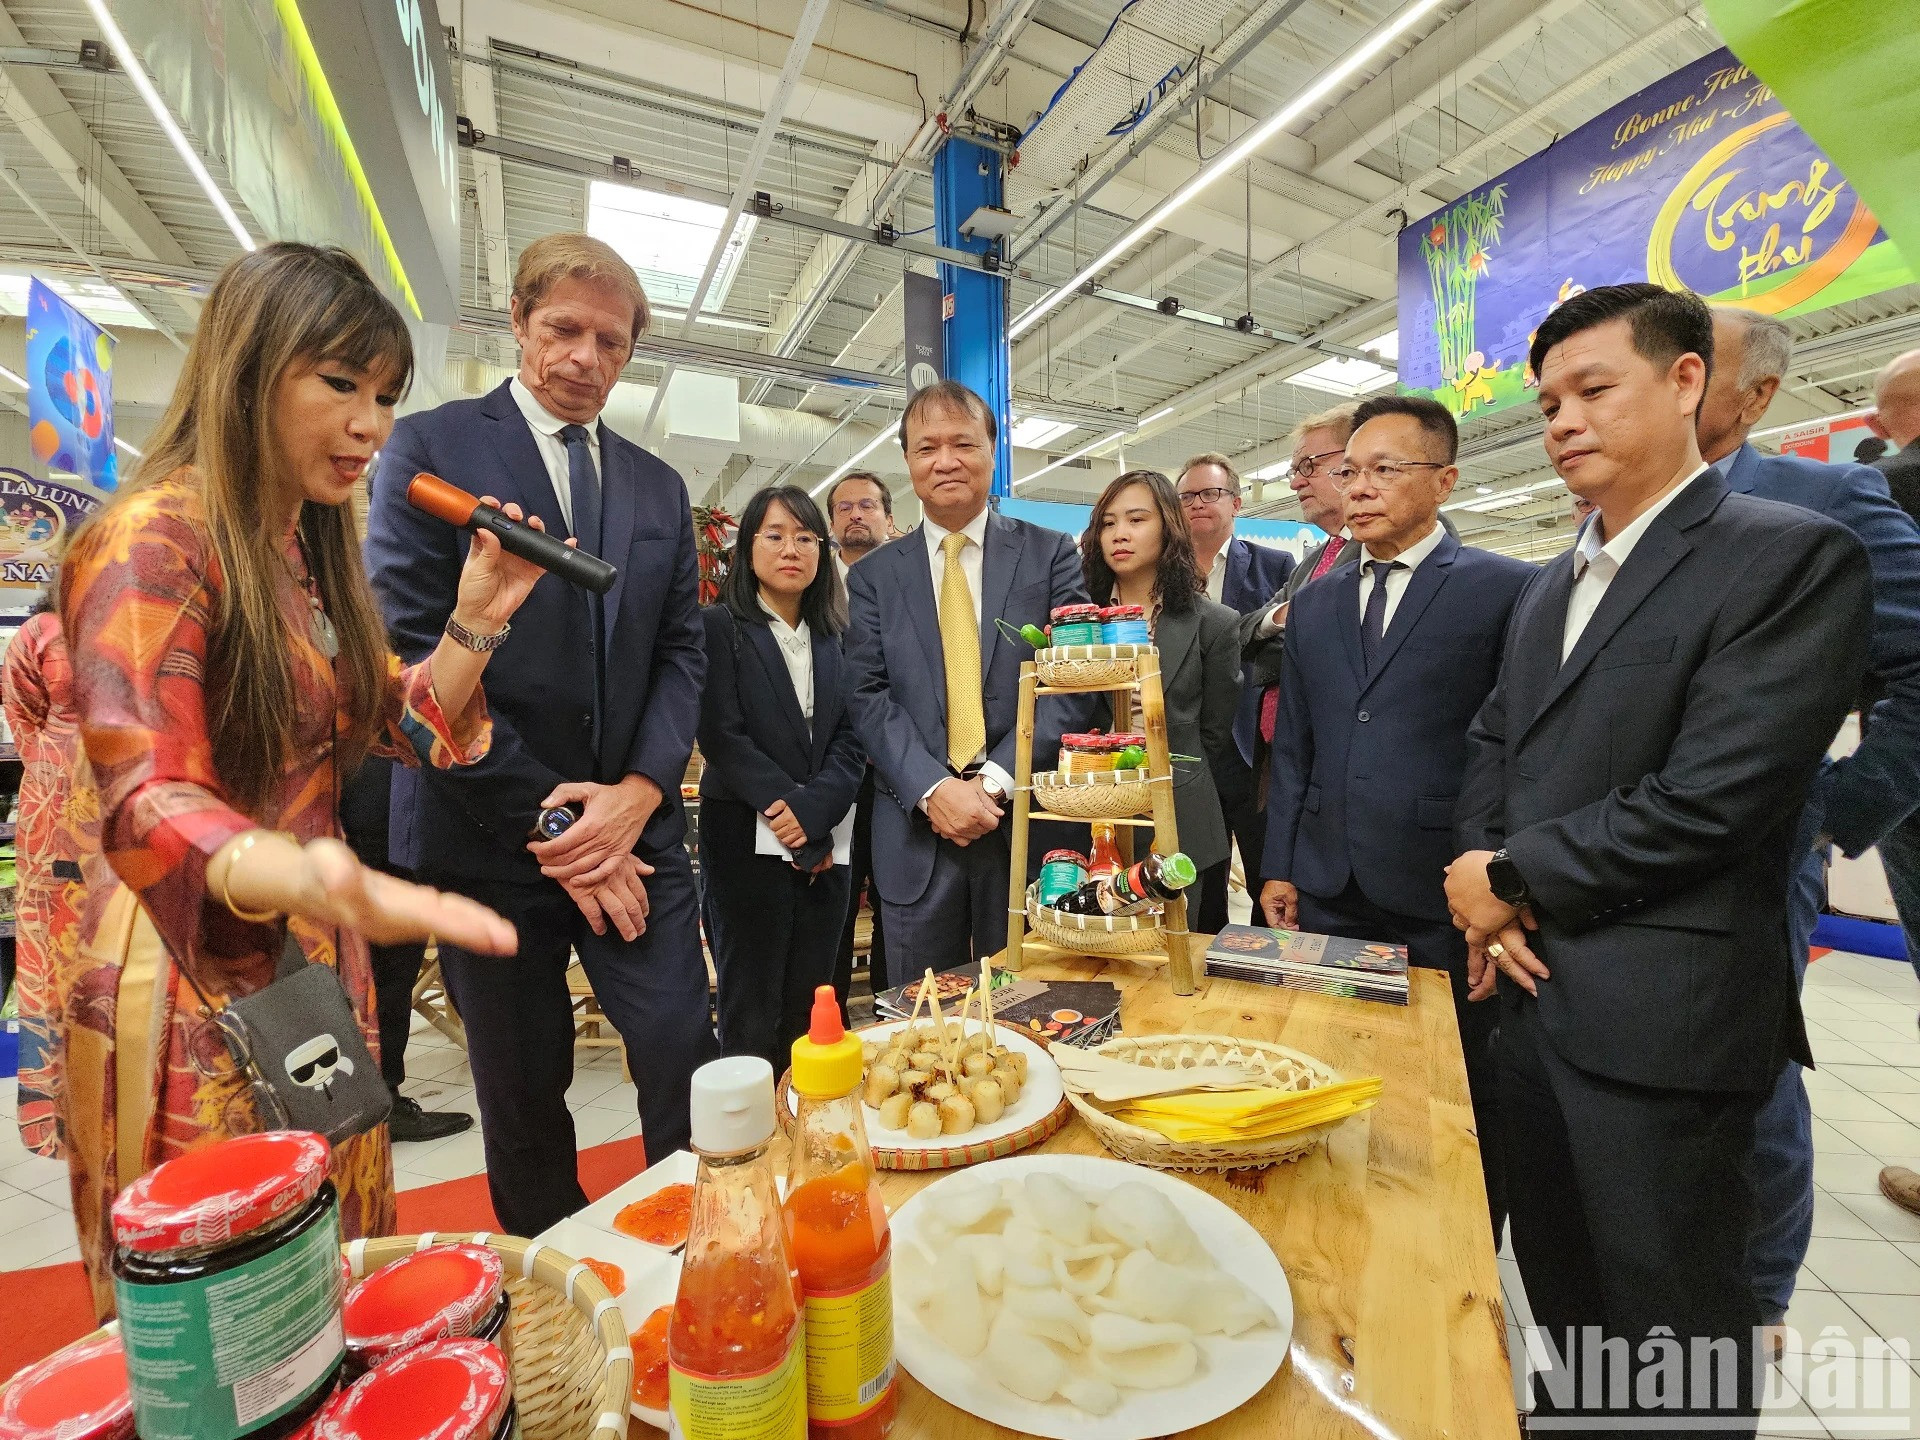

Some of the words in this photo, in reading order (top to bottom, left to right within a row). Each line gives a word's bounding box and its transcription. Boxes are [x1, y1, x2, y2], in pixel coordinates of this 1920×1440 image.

[1611, 94, 1695, 150] Bonne
[1578, 145, 1658, 194] Happy
[1793, 426, 1825, 438] SAISIR
[1, 480, 30, 495] LA
[34, 484, 99, 514] LUNE
